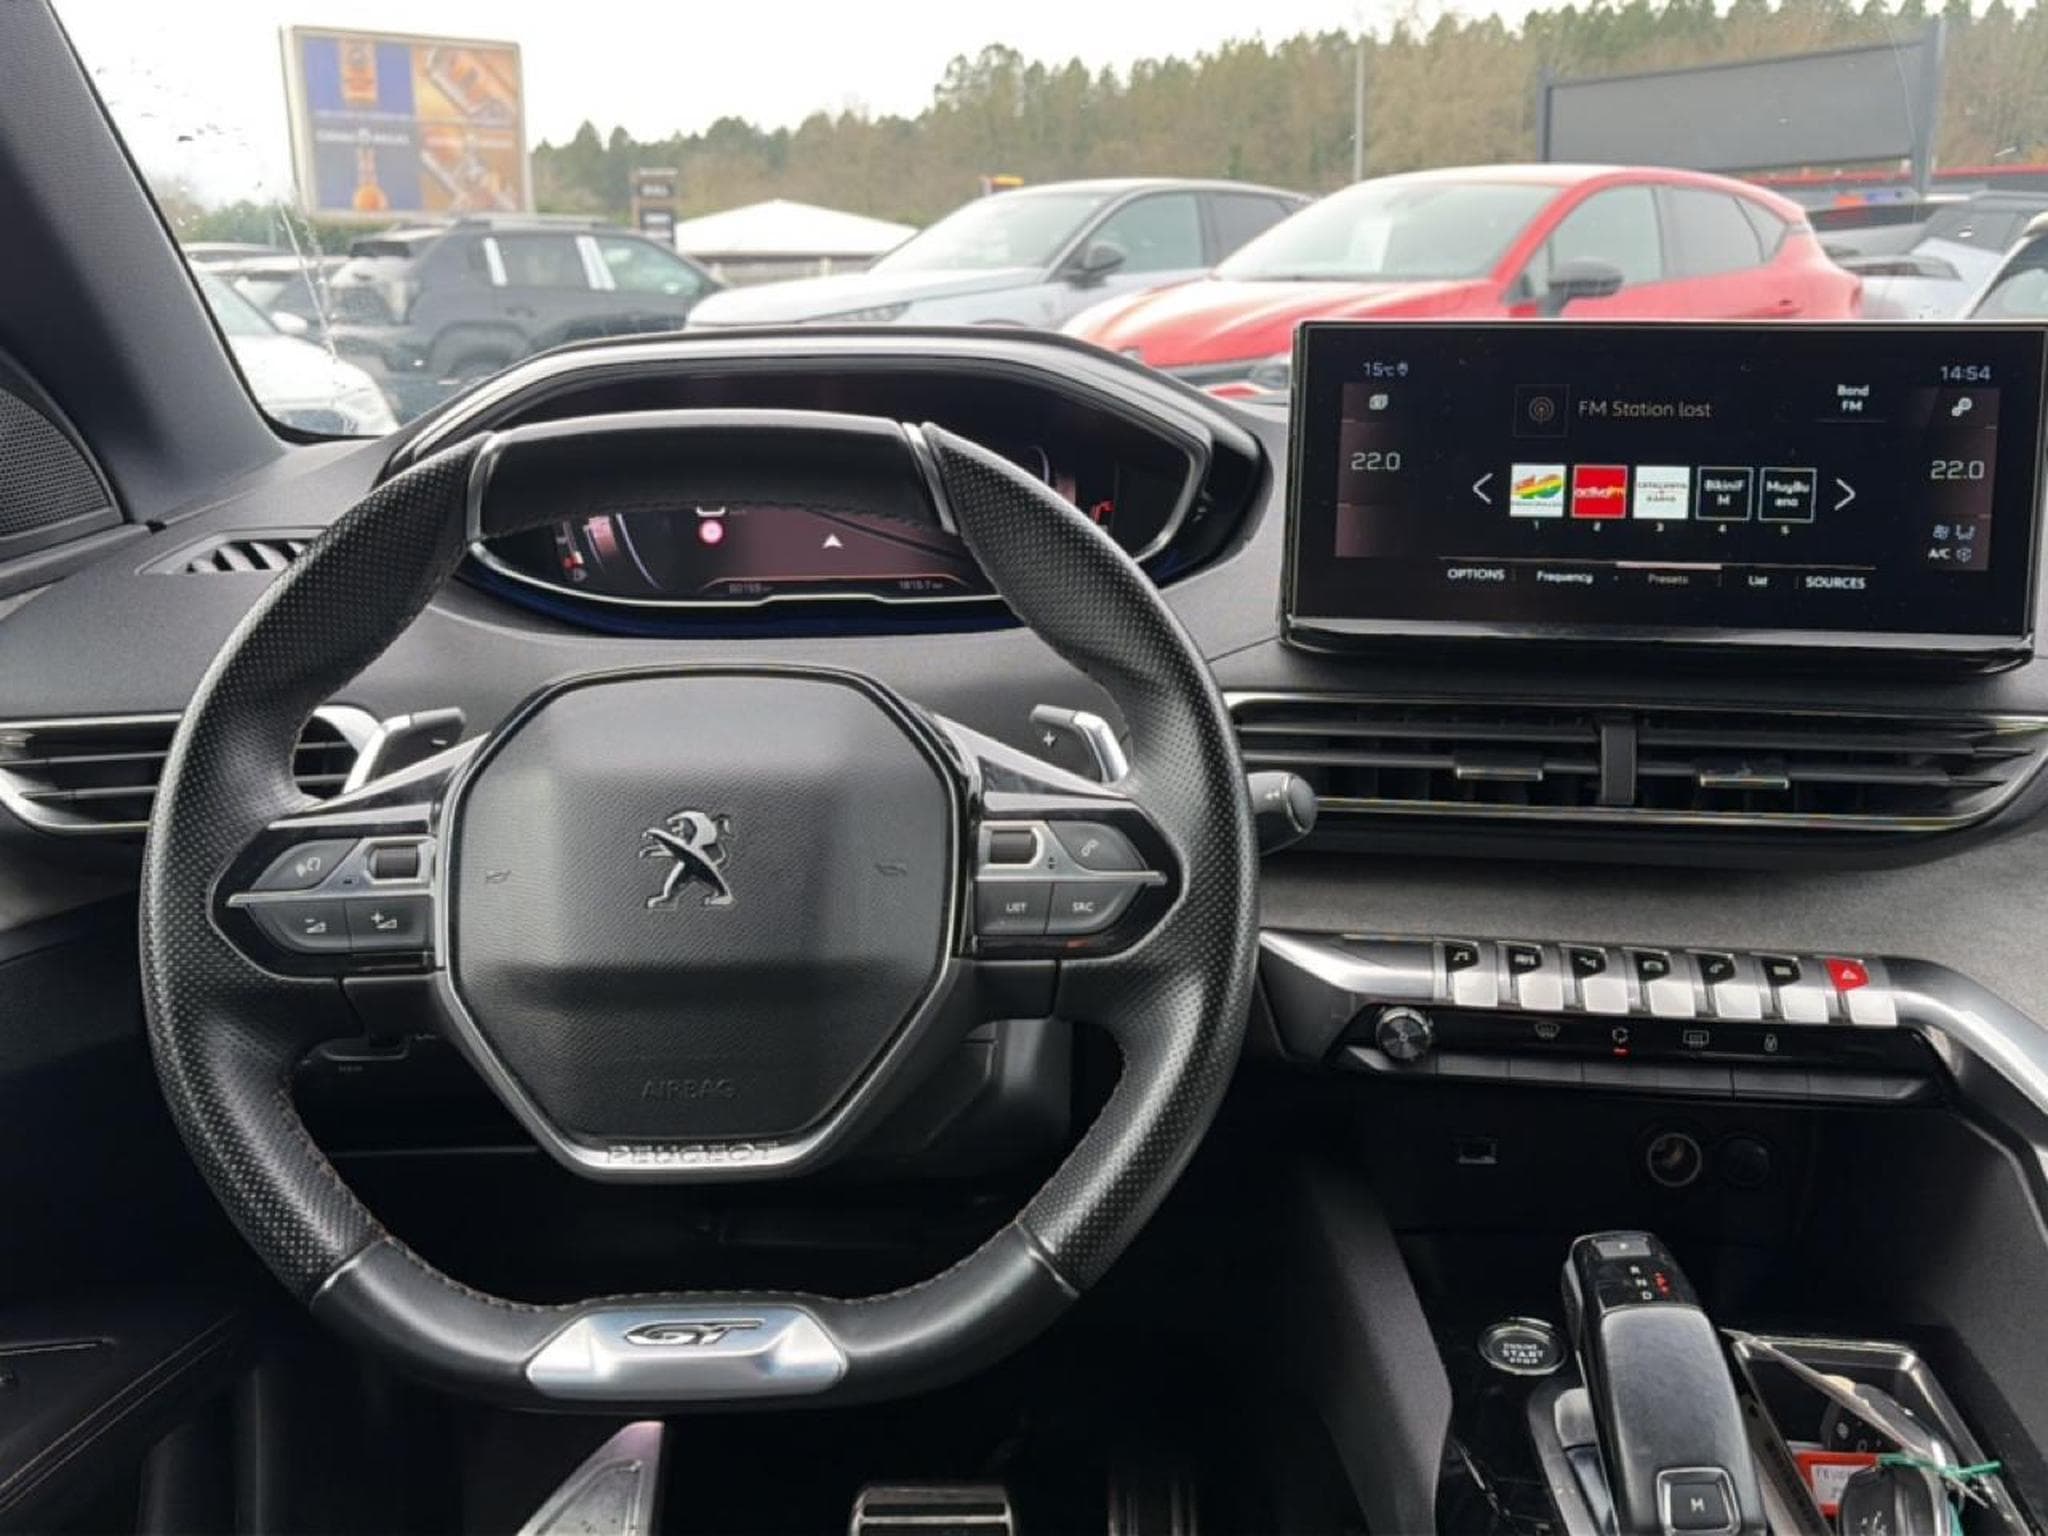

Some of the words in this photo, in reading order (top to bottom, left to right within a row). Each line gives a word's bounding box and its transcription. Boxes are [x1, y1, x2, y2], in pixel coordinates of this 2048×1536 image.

[1940, 365, 1991, 381] 14:54
[1836, 384, 1870, 397] Band
[1578, 400, 1608, 417] FM
[1611, 400, 1674, 418] Station
[1678, 401, 1713, 419] lost
[1841, 399, 1863, 412] FM
[1350, 451, 1401, 471] 22.0
[1930, 459, 1986, 480] 22.0
[1928, 547, 1951, 560] A/C
[1447, 568, 1505, 581] OPTIONS
[1537, 570, 1594, 585] Frequency
[1648, 574, 1689, 586] Presets
[1806, 576, 1866, 589] SOURCES
[1072, 901, 1094, 913] SRC
[606, 1142, 778, 1165] PEUGEOT
[624, 1318, 765, 1347] GT
